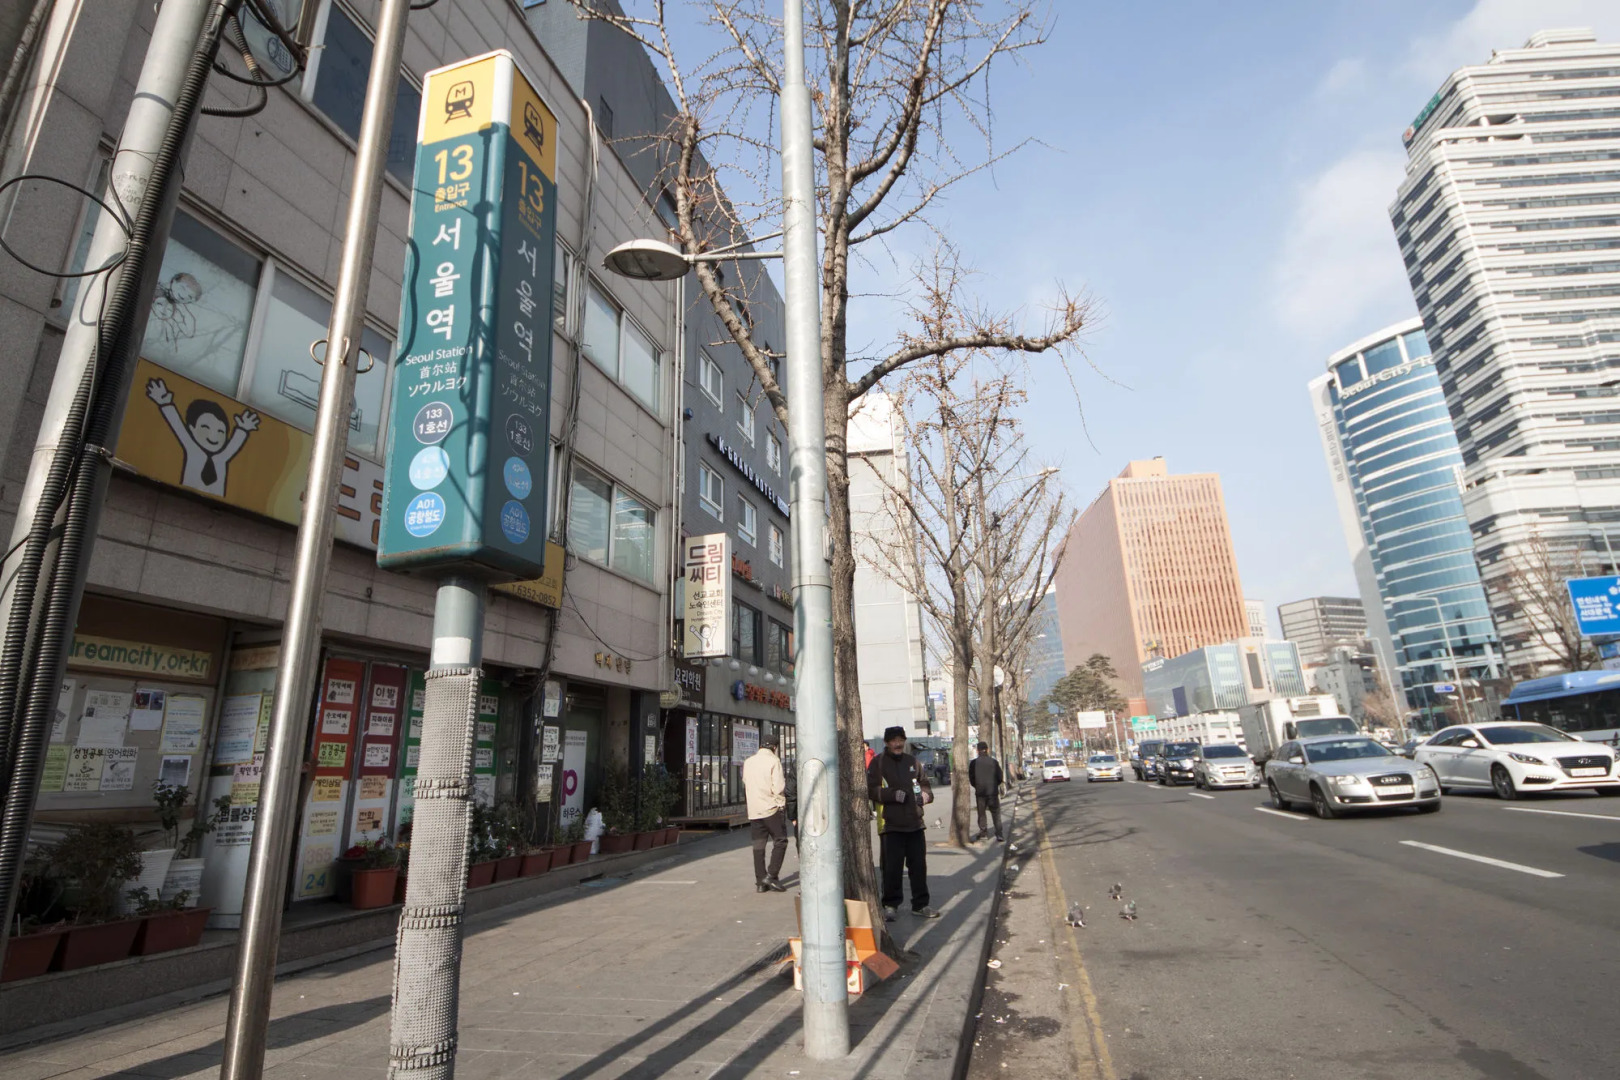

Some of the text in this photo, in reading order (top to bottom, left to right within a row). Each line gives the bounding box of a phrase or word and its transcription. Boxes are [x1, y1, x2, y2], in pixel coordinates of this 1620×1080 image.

[455, 86, 466, 98] M
[434, 144, 474, 185] 13
[434, 181, 471, 204] 출입구
[518, 161, 544, 213] 13
[434, 199, 468, 213] Entrance
[426, 217, 462, 341] 서울역
[514, 240, 537, 362] 서울역
[405, 344, 473, 366] Seoul Station
[499, 350, 520, 371] Seoul
[419, 361, 457, 379] 首尔站
[408, 376, 467, 398] ソウルヨク
[501, 383, 542, 417] ソウルヨク
[425, 408, 443, 420] 133
[418, 420, 448, 434] 1호선
[511, 430, 530, 451] 1호선
[755, 473, 776, 504] HOTEL
[416, 499, 435, 510] A01
[510, 506, 523, 519] A01
[408, 509, 441, 526] 공항철도
[687, 543, 723, 567] 드림
[689, 564, 721, 585] 씨티
[512, 584, 557, 607] T.6352-0852
[689, 600, 723, 610] 노숙인센터
[375, 687, 396, 700] 이발
[545, 701, 557, 714] 24
[74, 748, 104, 760] 성경공부
[106, 748, 138, 760] 영어회화
[320, 743, 346, 757] 성경공부
[315, 778, 342, 788] 개인상담
[563, 807, 582, 820] 하우스
[305, 872, 327, 890] 24
